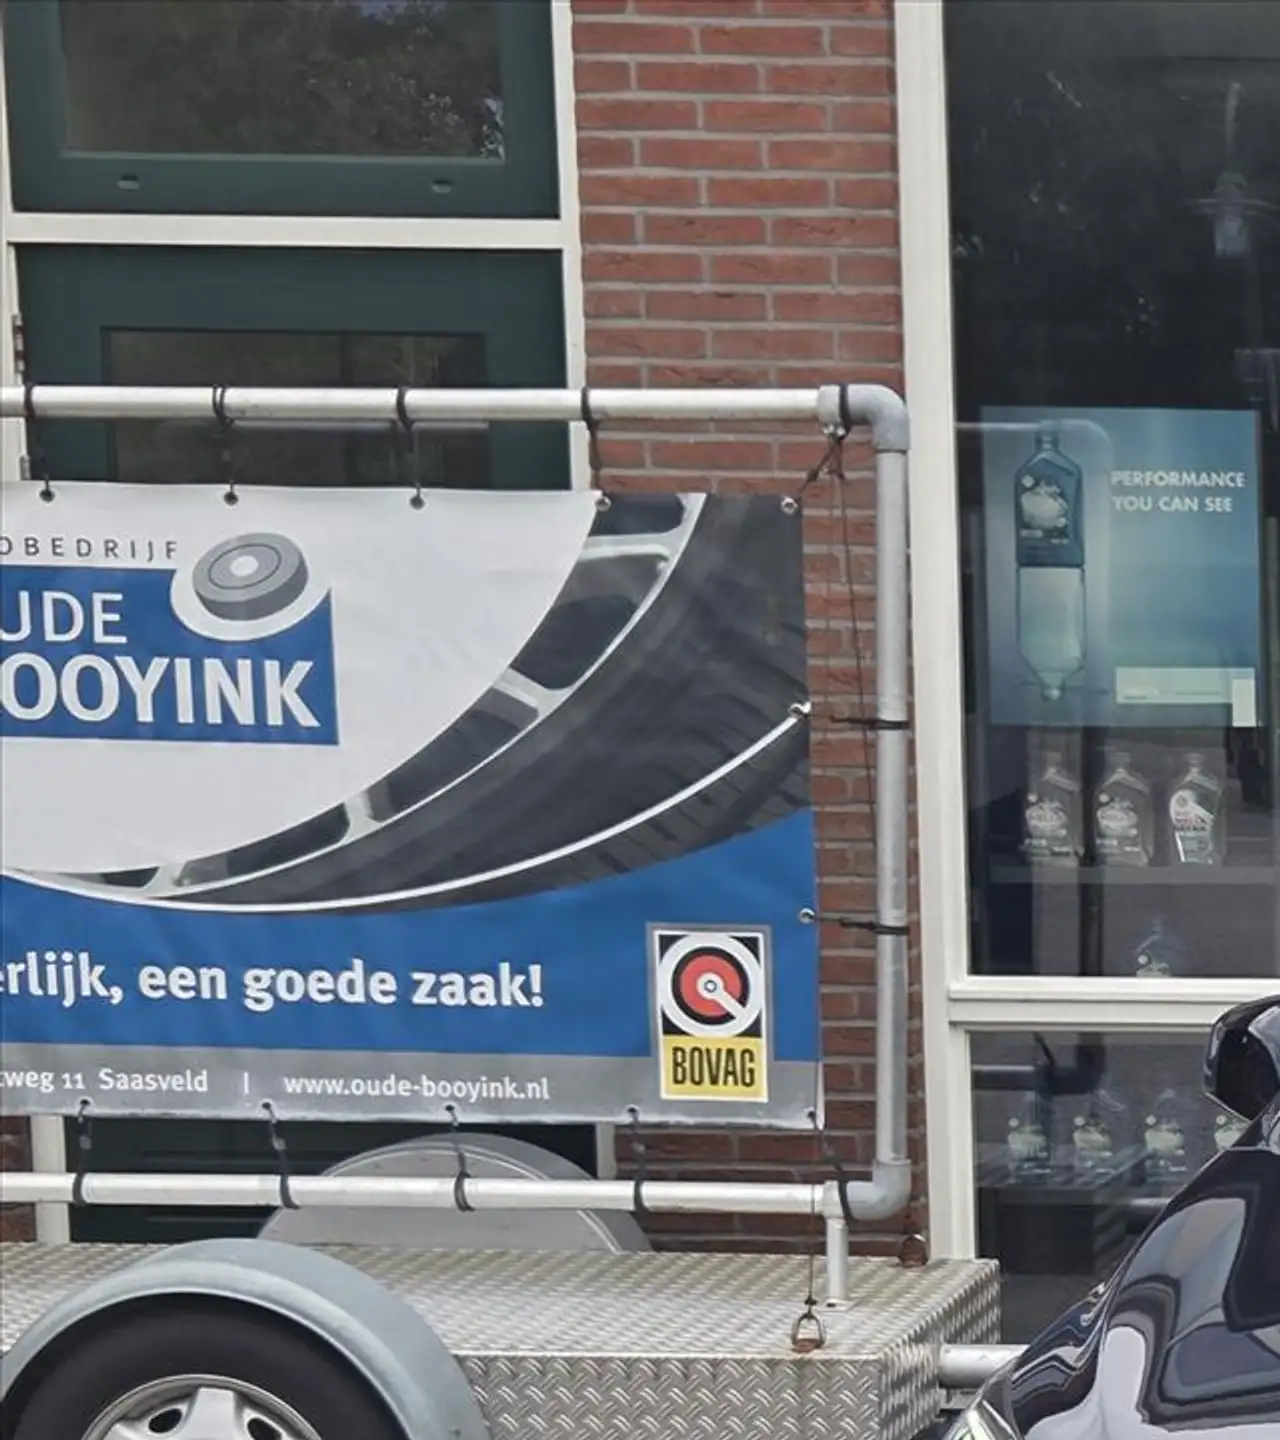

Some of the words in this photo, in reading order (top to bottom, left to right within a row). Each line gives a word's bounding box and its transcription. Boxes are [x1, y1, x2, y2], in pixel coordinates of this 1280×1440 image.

[1111, 470, 1246, 487] PERFORMANCE
[1112, 496, 1152, 512] YOU
[1158, 496, 1199, 512] CAN
[1204, 497, 1233, 512] SEE
[0, 652, 320, 727] OOYINK
[0, 951, 124, 1007] rlijk,
[138, 964, 227, 1000] een
[243, 958, 397, 1012] goede
[410, 962, 544, 1007] zaak!
[61, 1072, 86, 1090] 11
[99, 1067, 208, 1091] Saasveld
[284, 1074, 550, 1102] www.oude-booyink.nl
[672, 1046, 756, 1088] BOVAG
